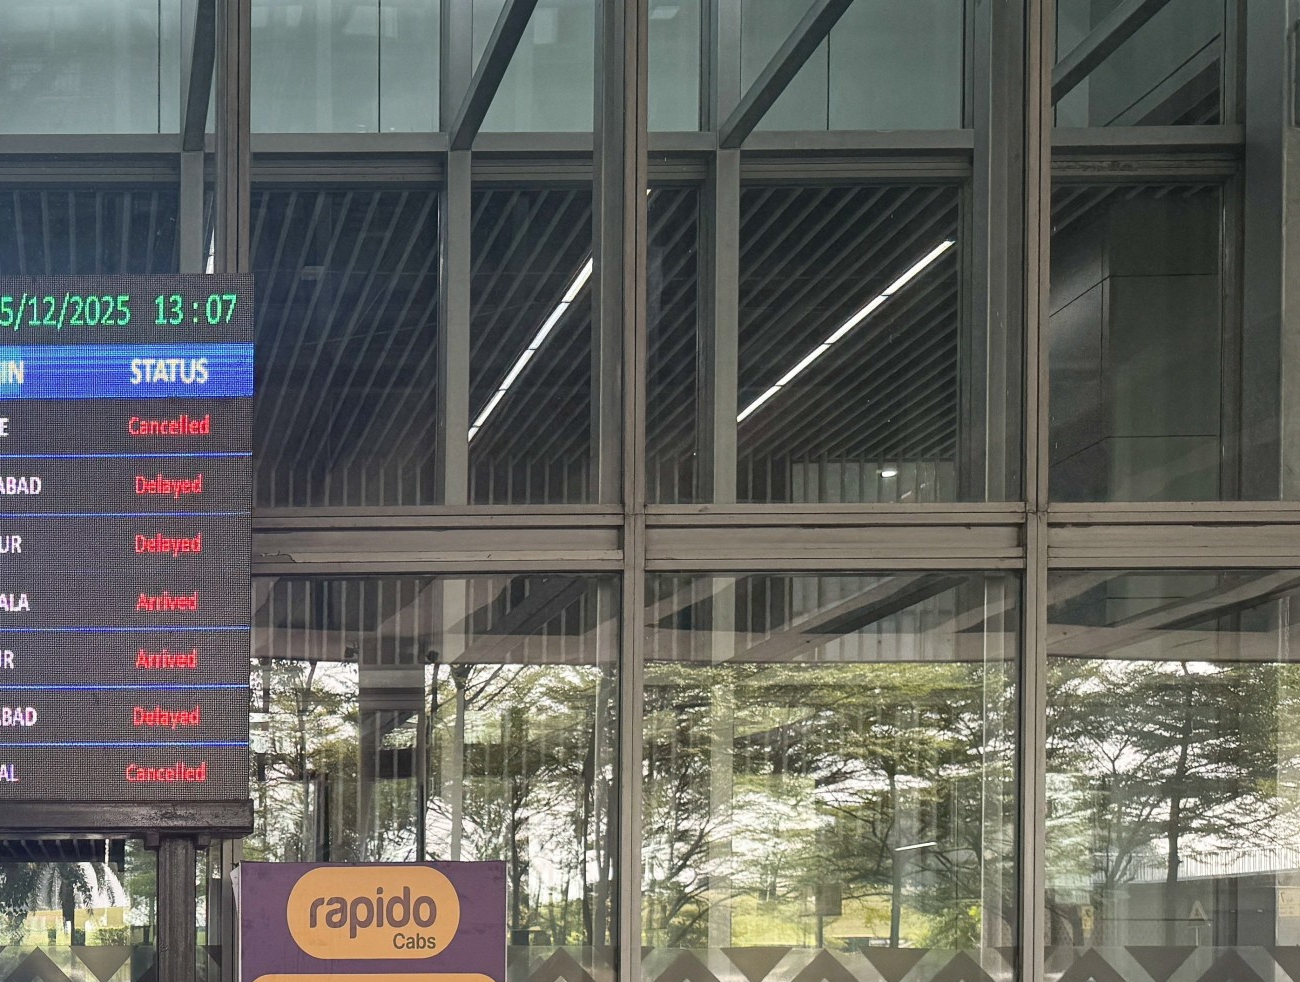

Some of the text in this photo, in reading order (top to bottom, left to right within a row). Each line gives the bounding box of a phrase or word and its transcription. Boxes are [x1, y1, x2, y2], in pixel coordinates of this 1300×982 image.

[130, 358, 210, 385] STATUS
[128, 414, 211, 437] Cancelled
[135, 473, 203, 499] Delayed
[135, 532, 202, 557] Delayed
[135, 591, 198, 612] Arrived
[135, 648, 198, 670] Arrived
[133, 705, 200, 730] Delayed
[125, 761, 207, 782] Cancelled
[309, 886, 437, 939] rapido
[393, 933, 436, 949] Cabs
